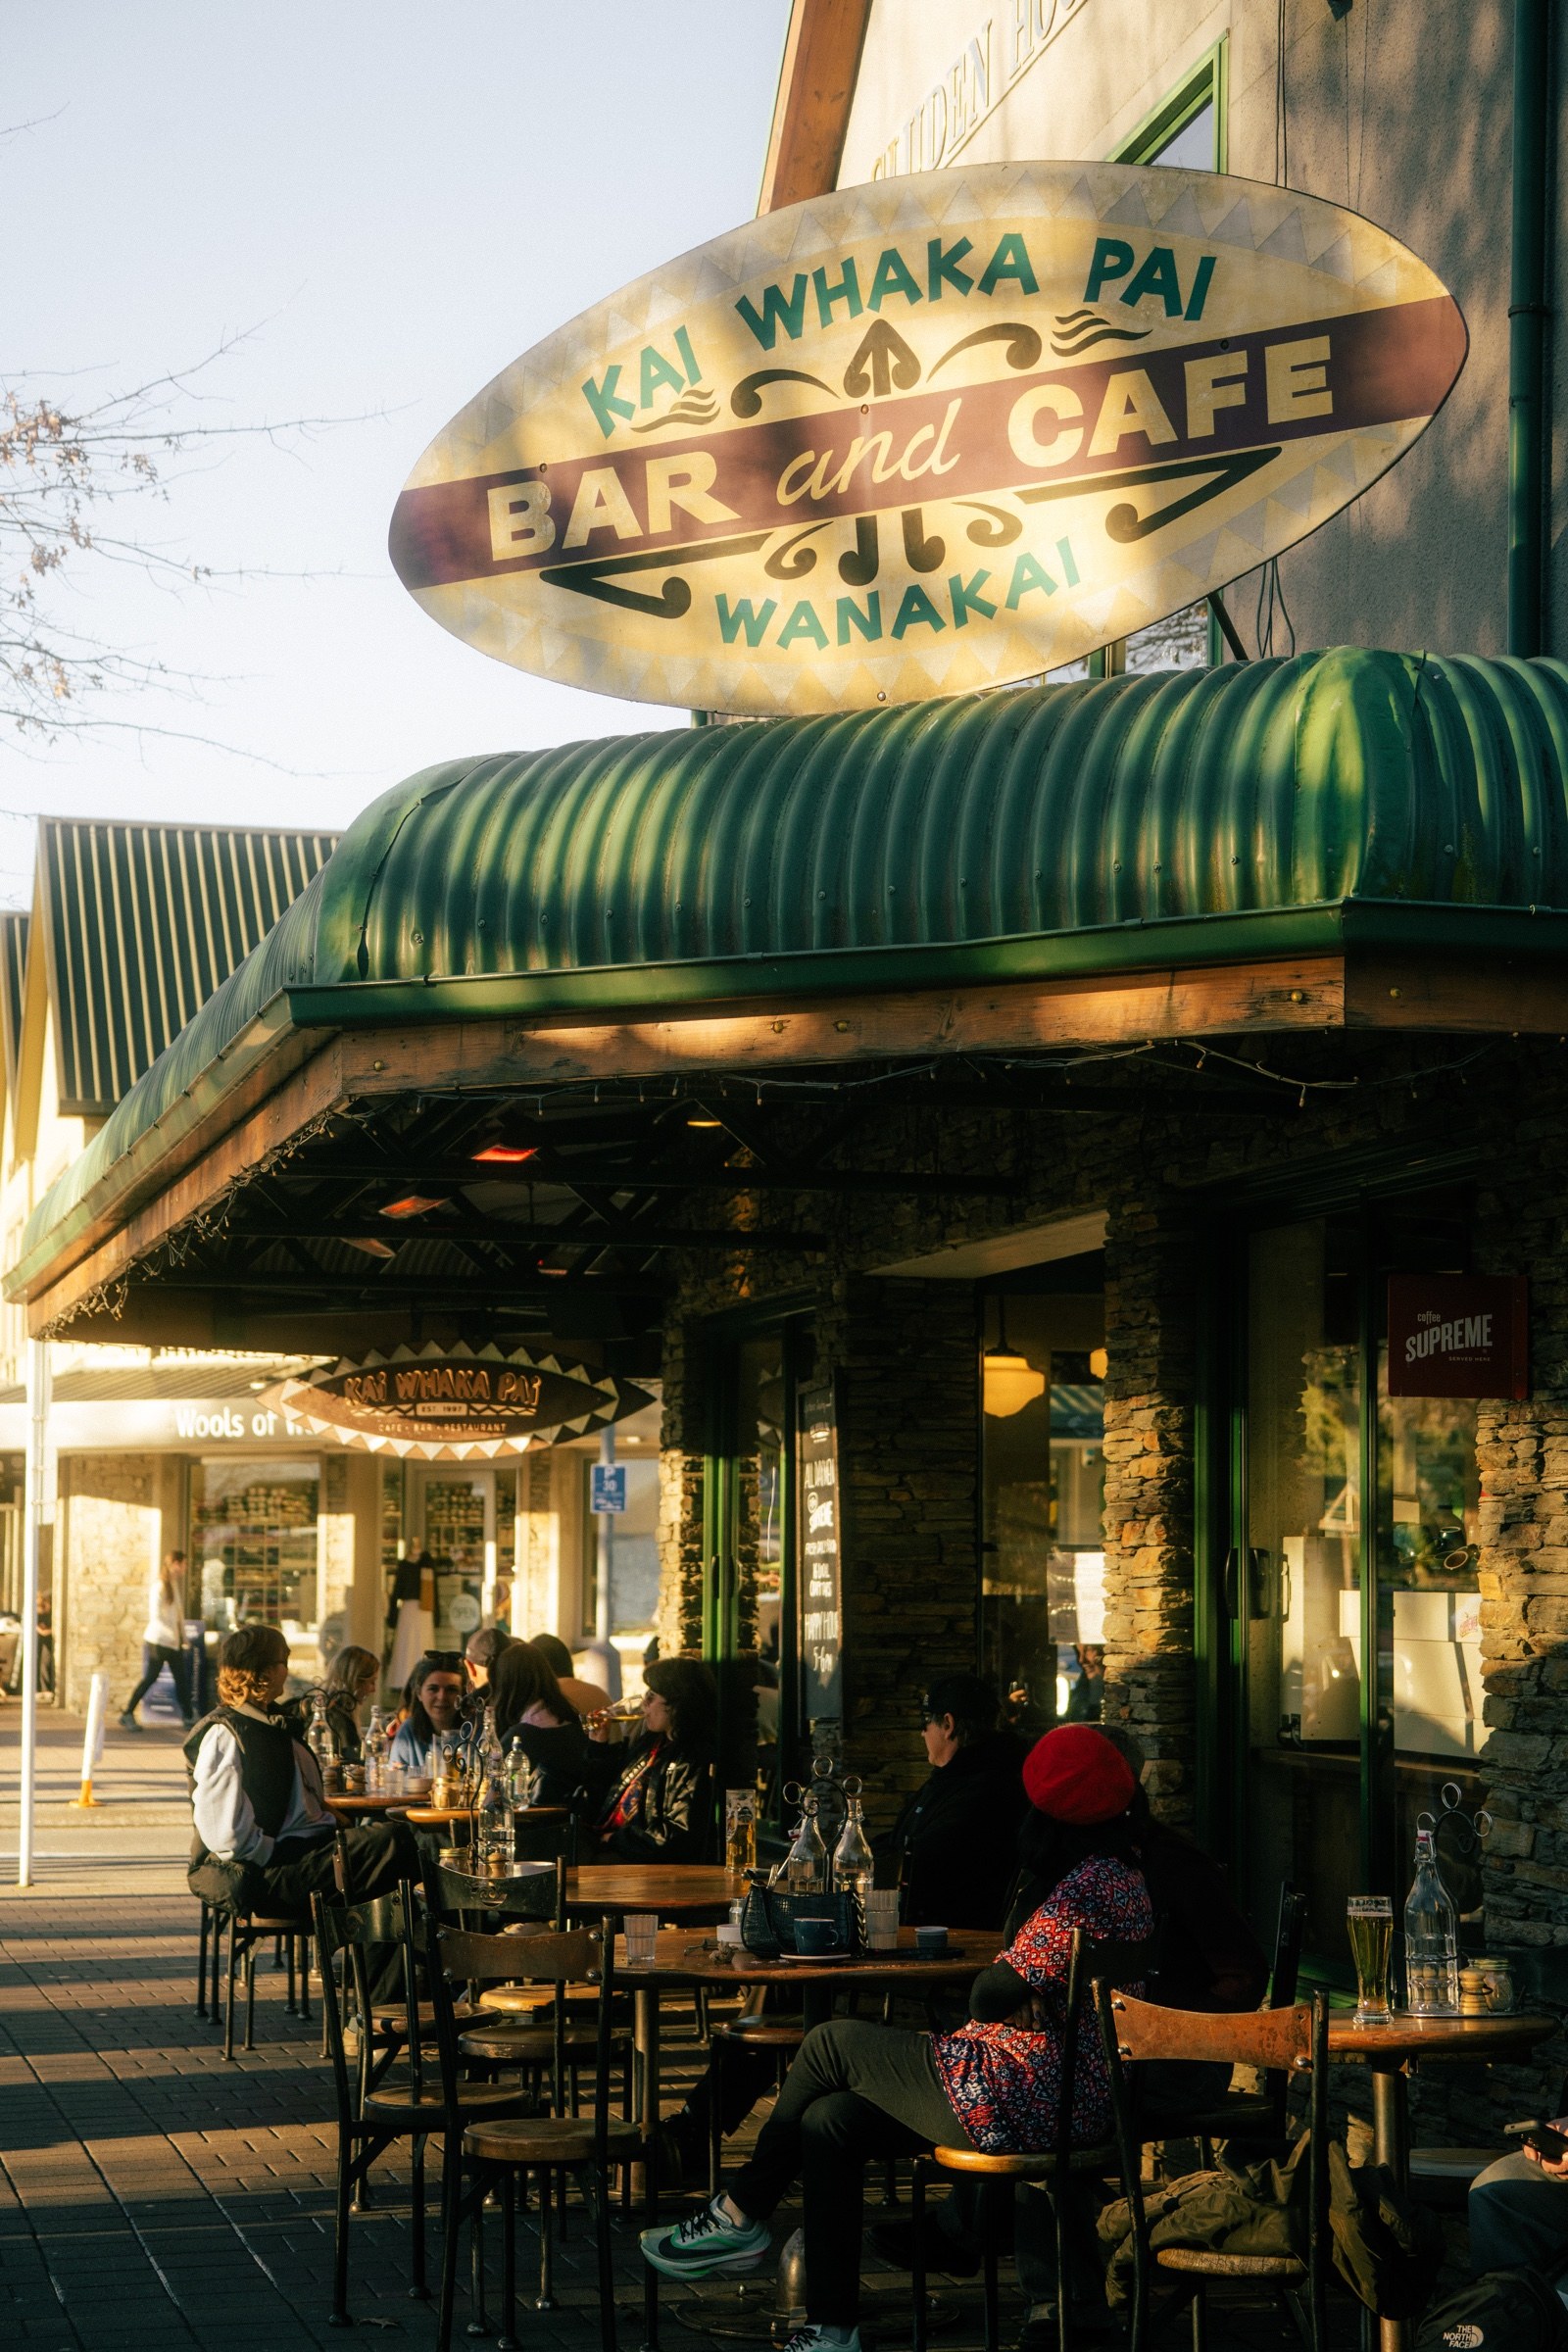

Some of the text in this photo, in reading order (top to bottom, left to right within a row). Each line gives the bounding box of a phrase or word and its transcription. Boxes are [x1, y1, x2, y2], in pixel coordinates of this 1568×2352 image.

[580, 232, 1218, 440] KAI WHAKA PAI
[486, 334, 1334, 562] BAR and CAFE
[713, 535, 1082, 652] WANAKAI
[1417, 1310, 1441, 1325] coffee
[1404, 1314, 1494, 1363] SUPREME
[395, 1368, 490, 1400] WHAKA
[443, 1404, 463, 1413] 1997
[176, 1405, 245, 1439] Wools
[444, 1423, 508, 1432] RESTAURANT
[1443, 2332, 1471, 2341] NORTH
[1456, 2325, 1472, 2333] THE
[1448, 2340, 1471, 2349] FACE
